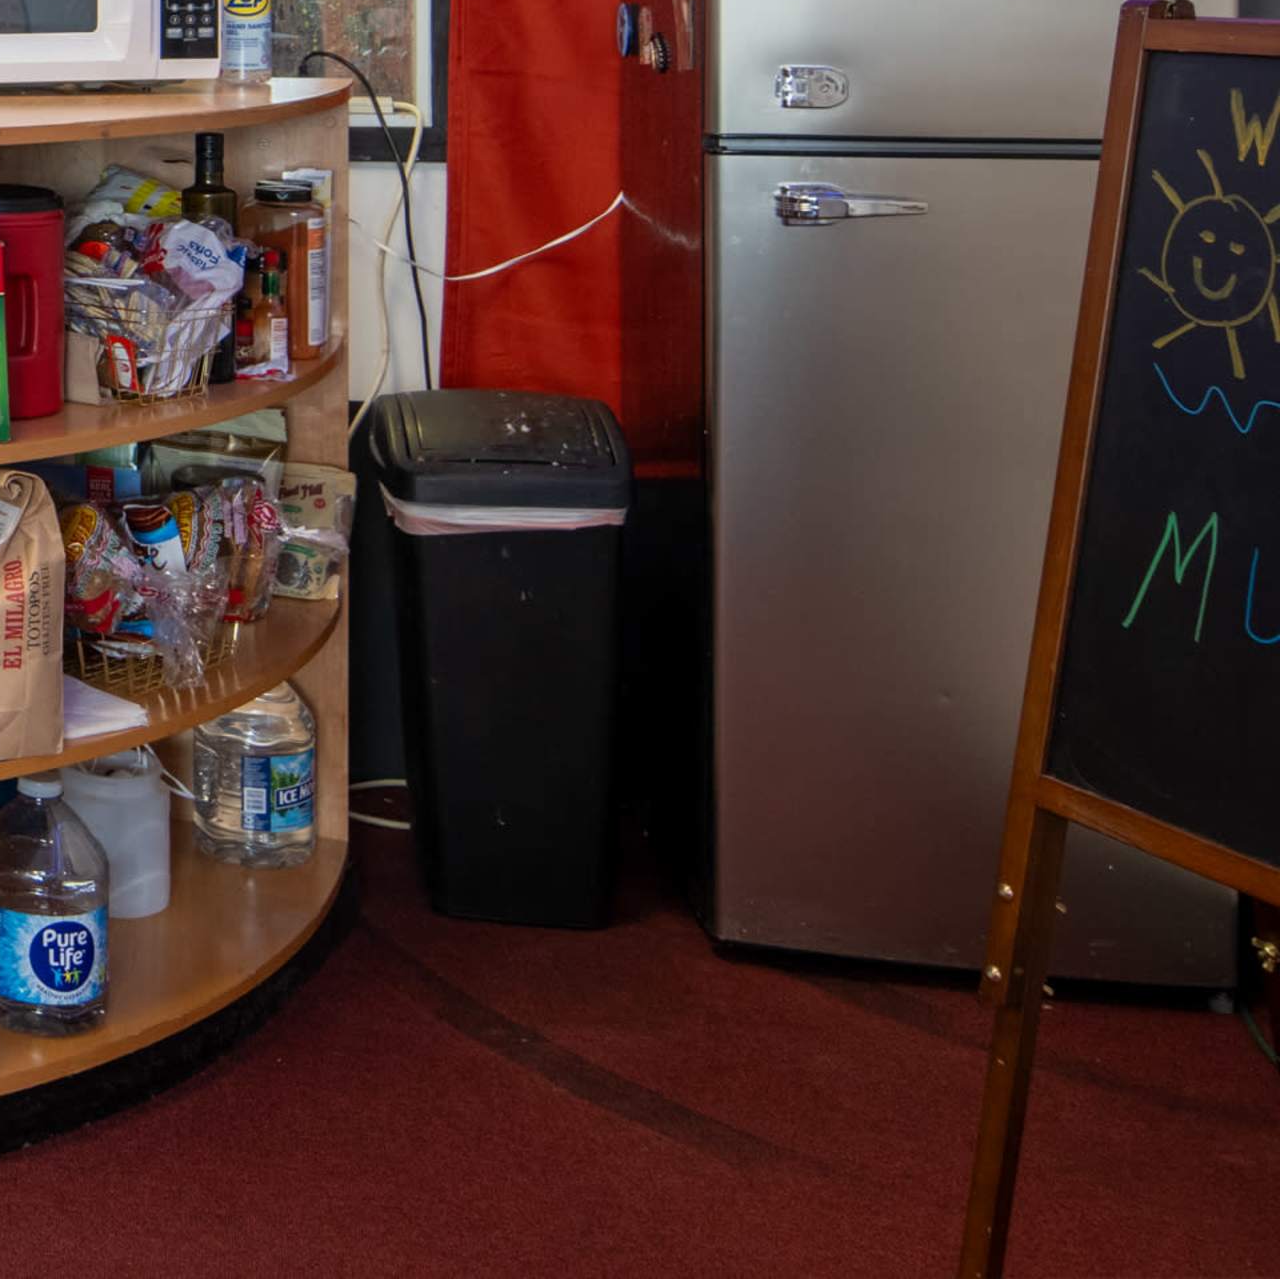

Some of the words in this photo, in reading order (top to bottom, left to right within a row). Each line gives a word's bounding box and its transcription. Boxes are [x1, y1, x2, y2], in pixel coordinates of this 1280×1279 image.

[3, 558, 25, 641] MILAGRO
[26, 570, 41, 651] TOTOPOS
[2, 645, 23, 671] EL
[279, 789, 299, 805] ICE
[42, 928, 88, 948] Pure
[48, 946, 84, 971] Life
